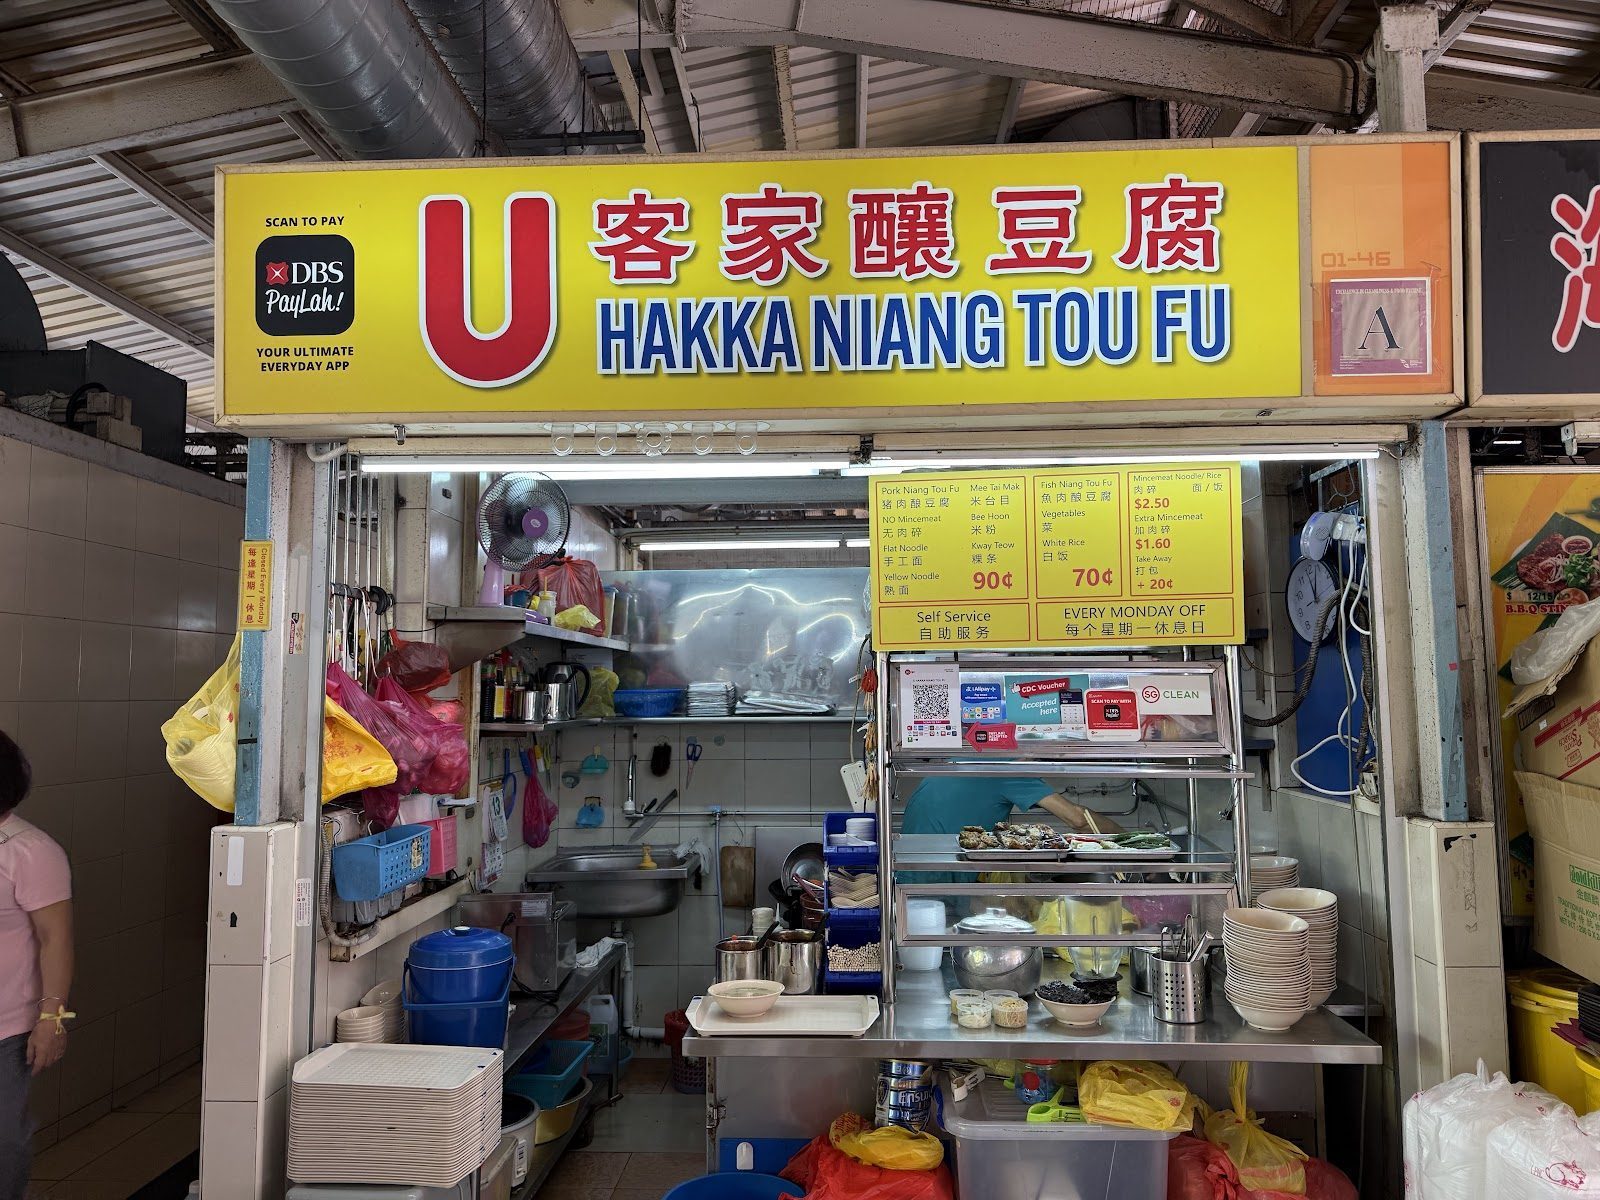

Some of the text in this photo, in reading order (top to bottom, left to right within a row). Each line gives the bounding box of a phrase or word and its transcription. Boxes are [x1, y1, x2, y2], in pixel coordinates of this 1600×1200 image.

[266, 216, 344, 227] SCAN TO PAY
[588, 173, 1224, 287] 客家釀豆腐
[1321, 251, 1390, 268] 01-46
[292, 261, 344, 284] DBS
[419, 190, 557, 388] U
[265, 287, 344, 318] PayLah!
[596, 284, 1230, 374] HAKKA NIANG TOU FU
[1358, 306, 1402, 350] A
[256, 346, 354, 357] YOUR ULTIMATE
[261, 361, 349, 372] EVERYDAY APP
[1134, 474, 1173, 482] Mincemeat
[1059, 480, 1083, 489] Niang
[882, 487, 900, 495] Pork
[904, 486, 929, 495] Niang
[882, 497, 950, 509] 猪肉酿豆腐
[970, 495, 1009, 506] 米台目
[1134, 497, 1169, 510] $2.50
[1042, 510, 1085, 519] Vegetables
[1157, 513, 1203, 521] Mincemeat
[971, 524, 996, 535] 米粉
[1042, 522, 1052, 532] 菜
[971, 542, 992, 550] Kway
[1135, 538, 1171, 550] $1.60
[884, 556, 922, 566] 手工面
[1043, 551, 1068, 562] 白饭
[1153, 555, 1172, 564] Away
[1136, 566, 1158, 576] 打包
[973, 572, 1013, 590] 90¢
[1072, 568, 1113, 587] 70¢
[1150, 578, 1173, 590] 20¢
[258, 596, 266, 624] Monday
[1064, 604, 1206, 619] EVERY MONDAY OFF
[1505, 604, 1538, 614] B.B.Q
[917, 610, 991, 623] Self Service
[919, 625, 990, 640] 自助服务
[1065, 621, 1205, 636] 每个星期一休息日
[1038, 681, 1066, 690] Voucher
[1022, 698, 1057, 710] Accepted
[1040, 707, 1058, 715] here
